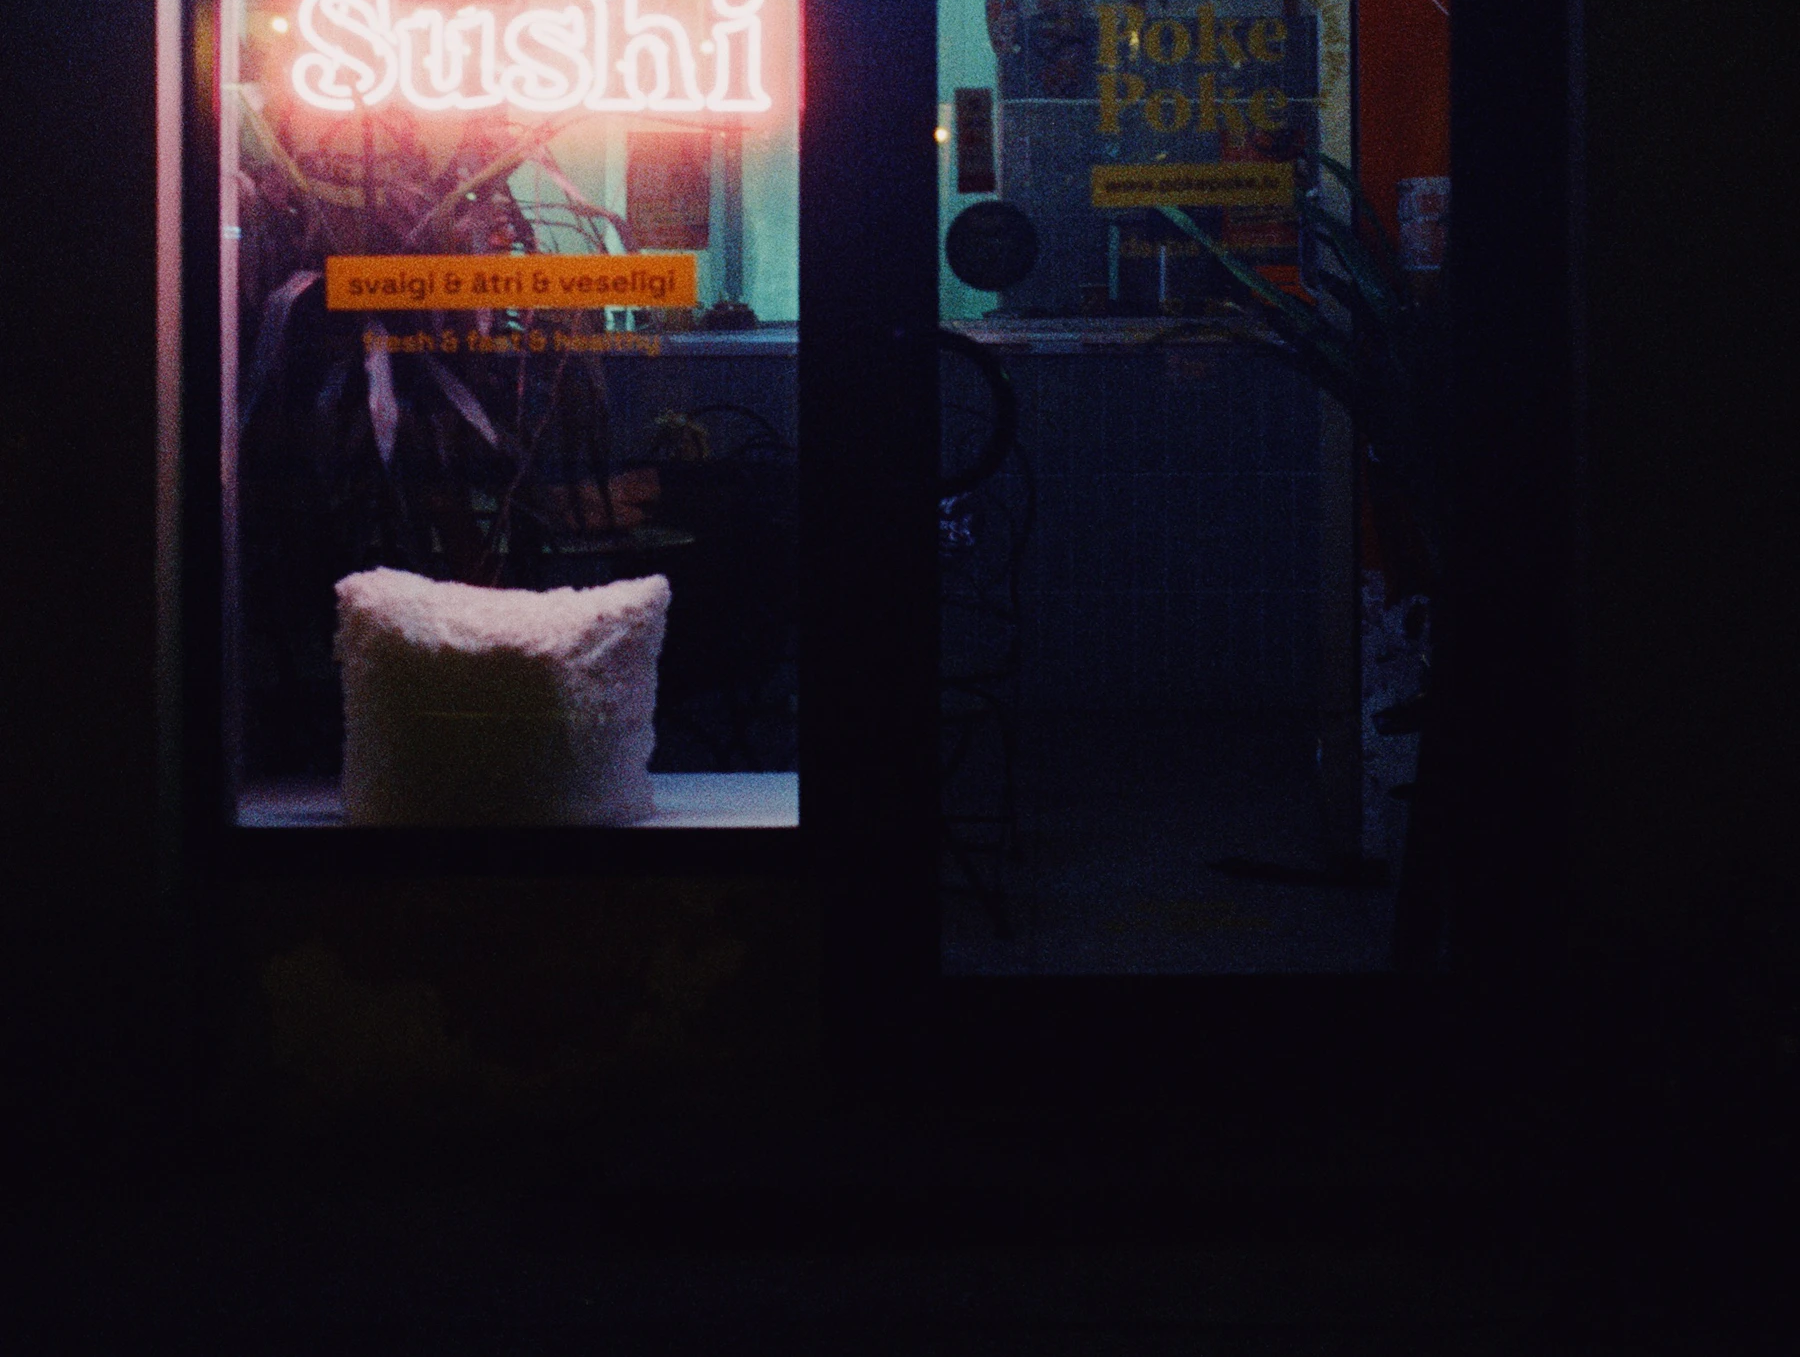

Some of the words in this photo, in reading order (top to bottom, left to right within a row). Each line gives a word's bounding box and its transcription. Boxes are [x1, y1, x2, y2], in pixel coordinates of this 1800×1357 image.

[1096, 3, 1288, 69] Poke
[1096, 70, 1288, 133] Poke
[348, 274, 436, 299] svaigi
[444, 272, 462, 294] &
[532, 270, 552, 294] &
[363, 330, 435, 353] fresh
[441, 330, 459, 353] &
[466, 330, 522, 353] fast
[529, 330, 547, 353] &
[554, 330, 662, 356] healthy
